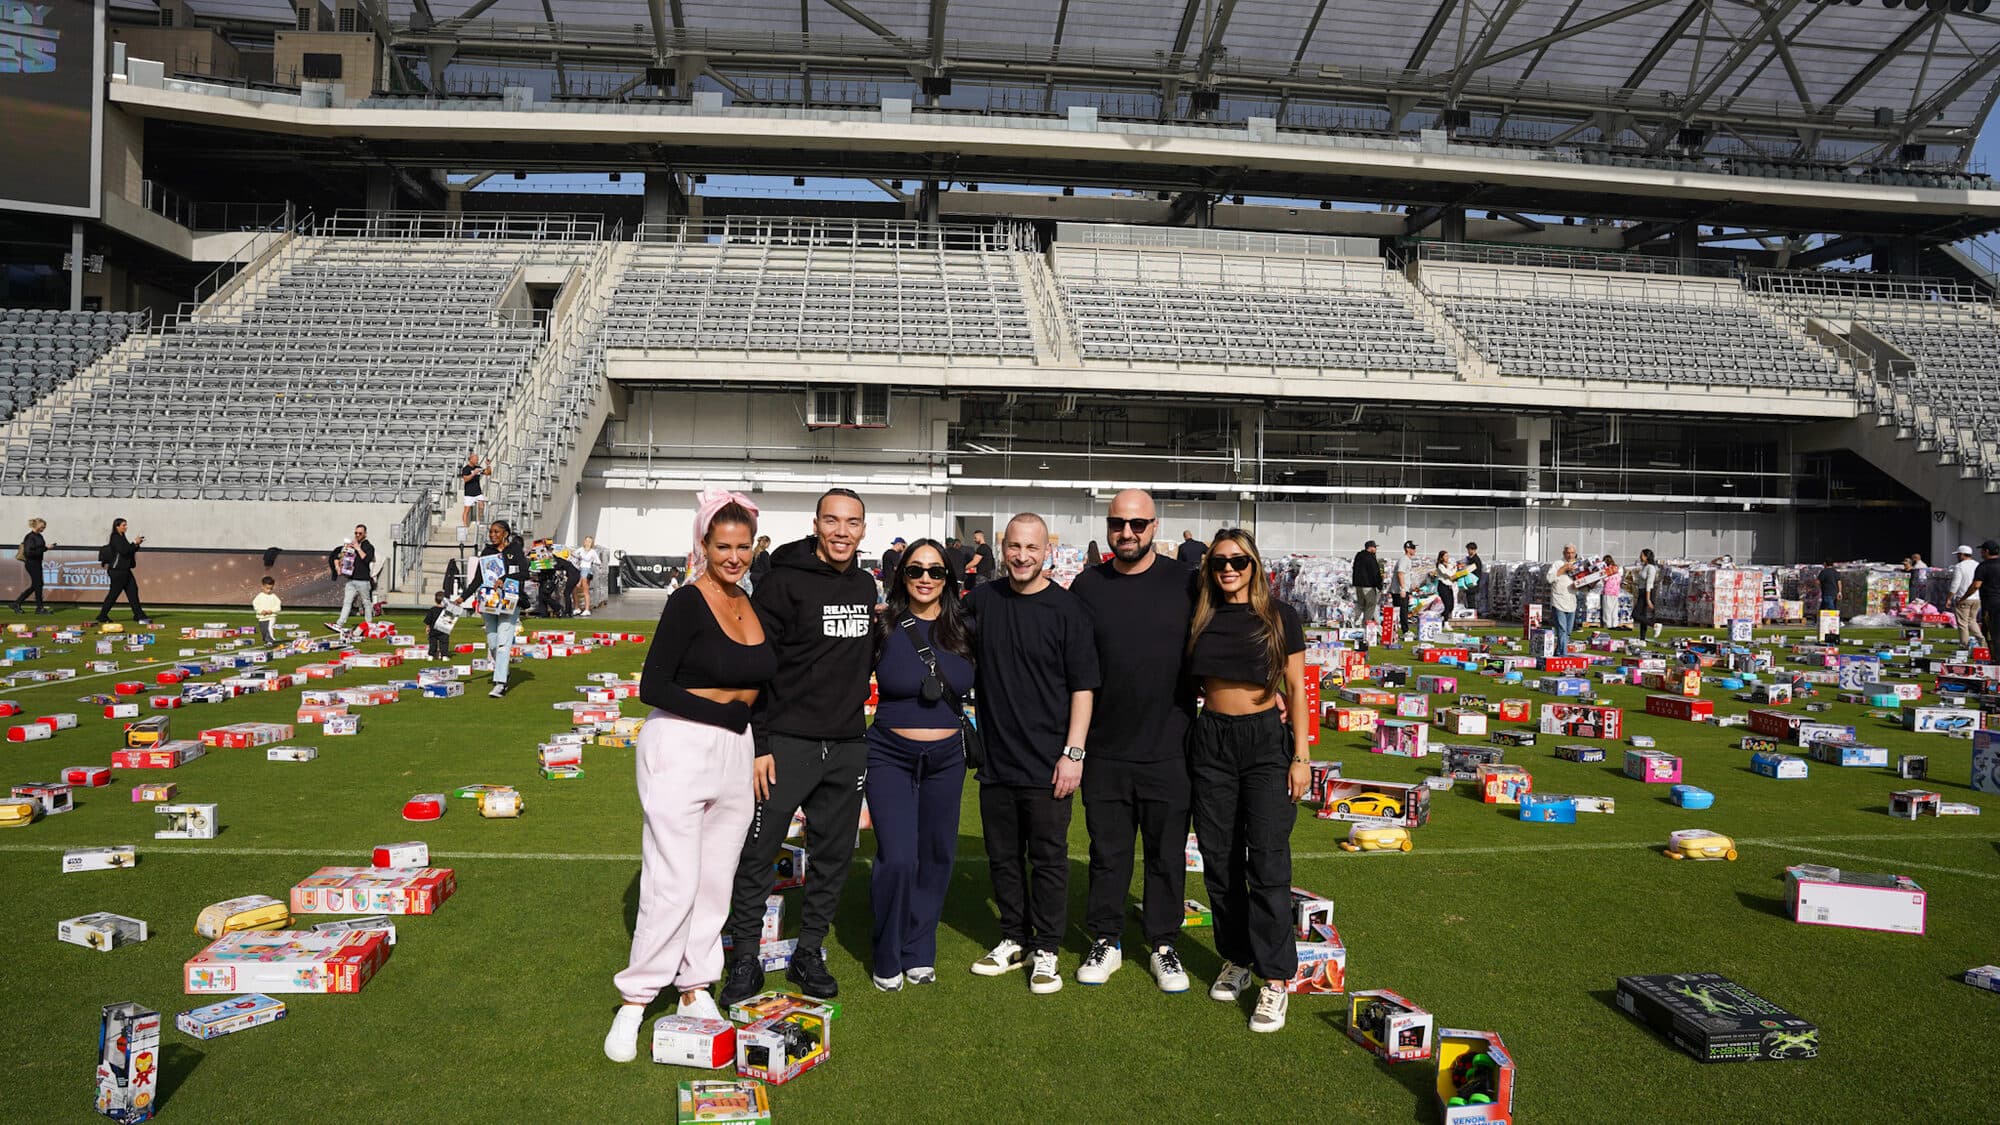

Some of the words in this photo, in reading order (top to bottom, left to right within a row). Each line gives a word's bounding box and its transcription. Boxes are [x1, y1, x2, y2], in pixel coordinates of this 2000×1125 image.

[62, 574, 88, 584] TOY
[90, 575, 112, 584] DRI
[823, 604, 868, 614] REALITY
[823, 619, 870, 638] GAMES
[1710, 1046, 1760, 1054] STRIKER-X
[1453, 1115, 1486, 1125] VENOM
